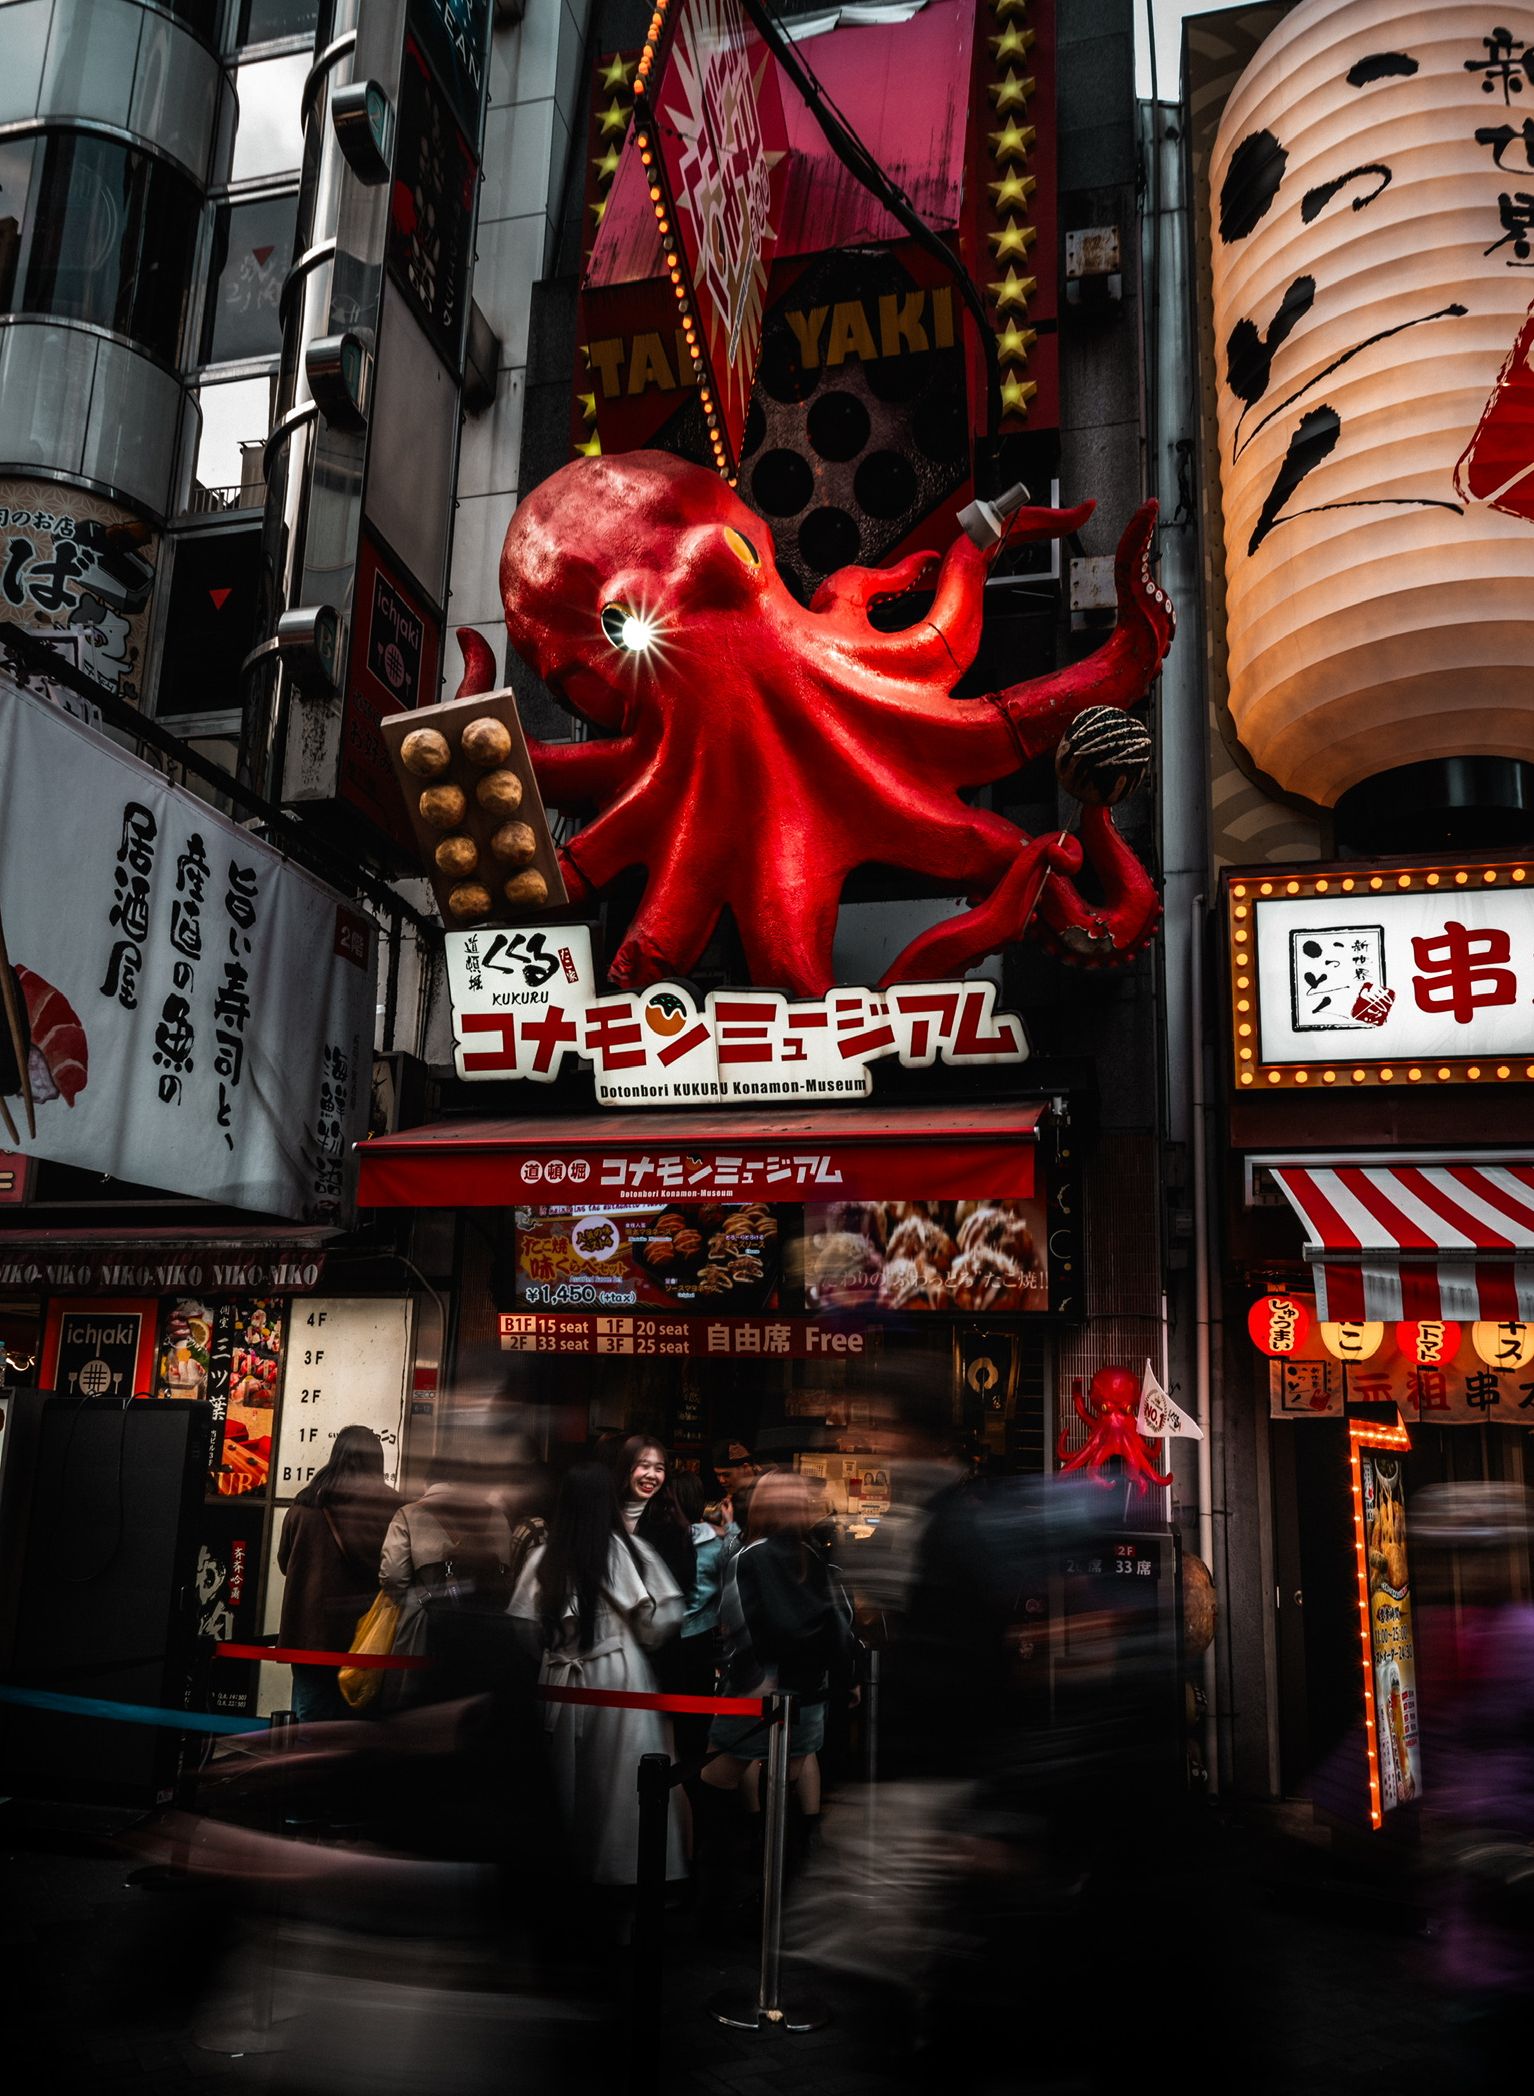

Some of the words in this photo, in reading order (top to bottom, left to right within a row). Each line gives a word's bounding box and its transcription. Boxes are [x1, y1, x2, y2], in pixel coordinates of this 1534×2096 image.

[785, 285, 955, 370] YAKI
[100, 802, 158, 1010] 居酒屋
[482, 932, 560, 987] くくる
[1411, 921, 1517, 1025] 串
[492, 991, 549, 1006] KUKURU
[461, 992, 1019, 1073] コナモンミュージアム
[600, 1083, 670, 1099] Dotonbori
[673, 1081, 729, 1097] KUKURU
[733, 1077, 867, 1096] Konamon-Museum
[523, 1161, 588, 1182] 道頓堀
[600, 1153, 843, 1186] コナモンミュージアム
[620, 1189, 659, 1198] Dotonbori
[661, 1188, 733, 1197] Konamon-Museum
[100, 1263, 203, 1287] NIKO-NIKO
[526, 1284, 597, 1306] ¥1,450
[599, 1291, 637, 1305] (+tax)
[307, 1313, 327, 1327] 4F
[505, 1317, 532, 1332] B1F
[539, 1319, 556, 1333] 15
[560, 1320, 588, 1334] seat
[606, 1319, 624, 1333] 1F
[637, 1321, 656, 1336] 20
[659, 1323, 689, 1336] seat
[1272, 1299, 1299, 1351] しゅうまい
[510, 1336, 528, 1350] 2F
[538, 1336, 556, 1350] 33
[560, 1337, 588, 1351] seat
[607, 1338, 624, 1352] 3F
[637, 1339, 656, 1353] 25
[659, 1340, 689, 1354] seat
[707, 1323, 791, 1353] 自由席
[805, 1326, 864, 1352] Free
[304, 1351, 324, 1365] 3F
[210, 1337, 232, 1421] 三ツ葉
[301, 1390, 321, 1403] 2F
[1144, 1402, 1165, 1429] NO.1
[299, 1428, 318, 1442] 1F
[284, 1467, 315, 1482] B1F
[1117, 1545, 1134, 1556] 2F
[1115, 1560, 1132, 1574] 33
[1136, 1560, 1151, 1576] 席
